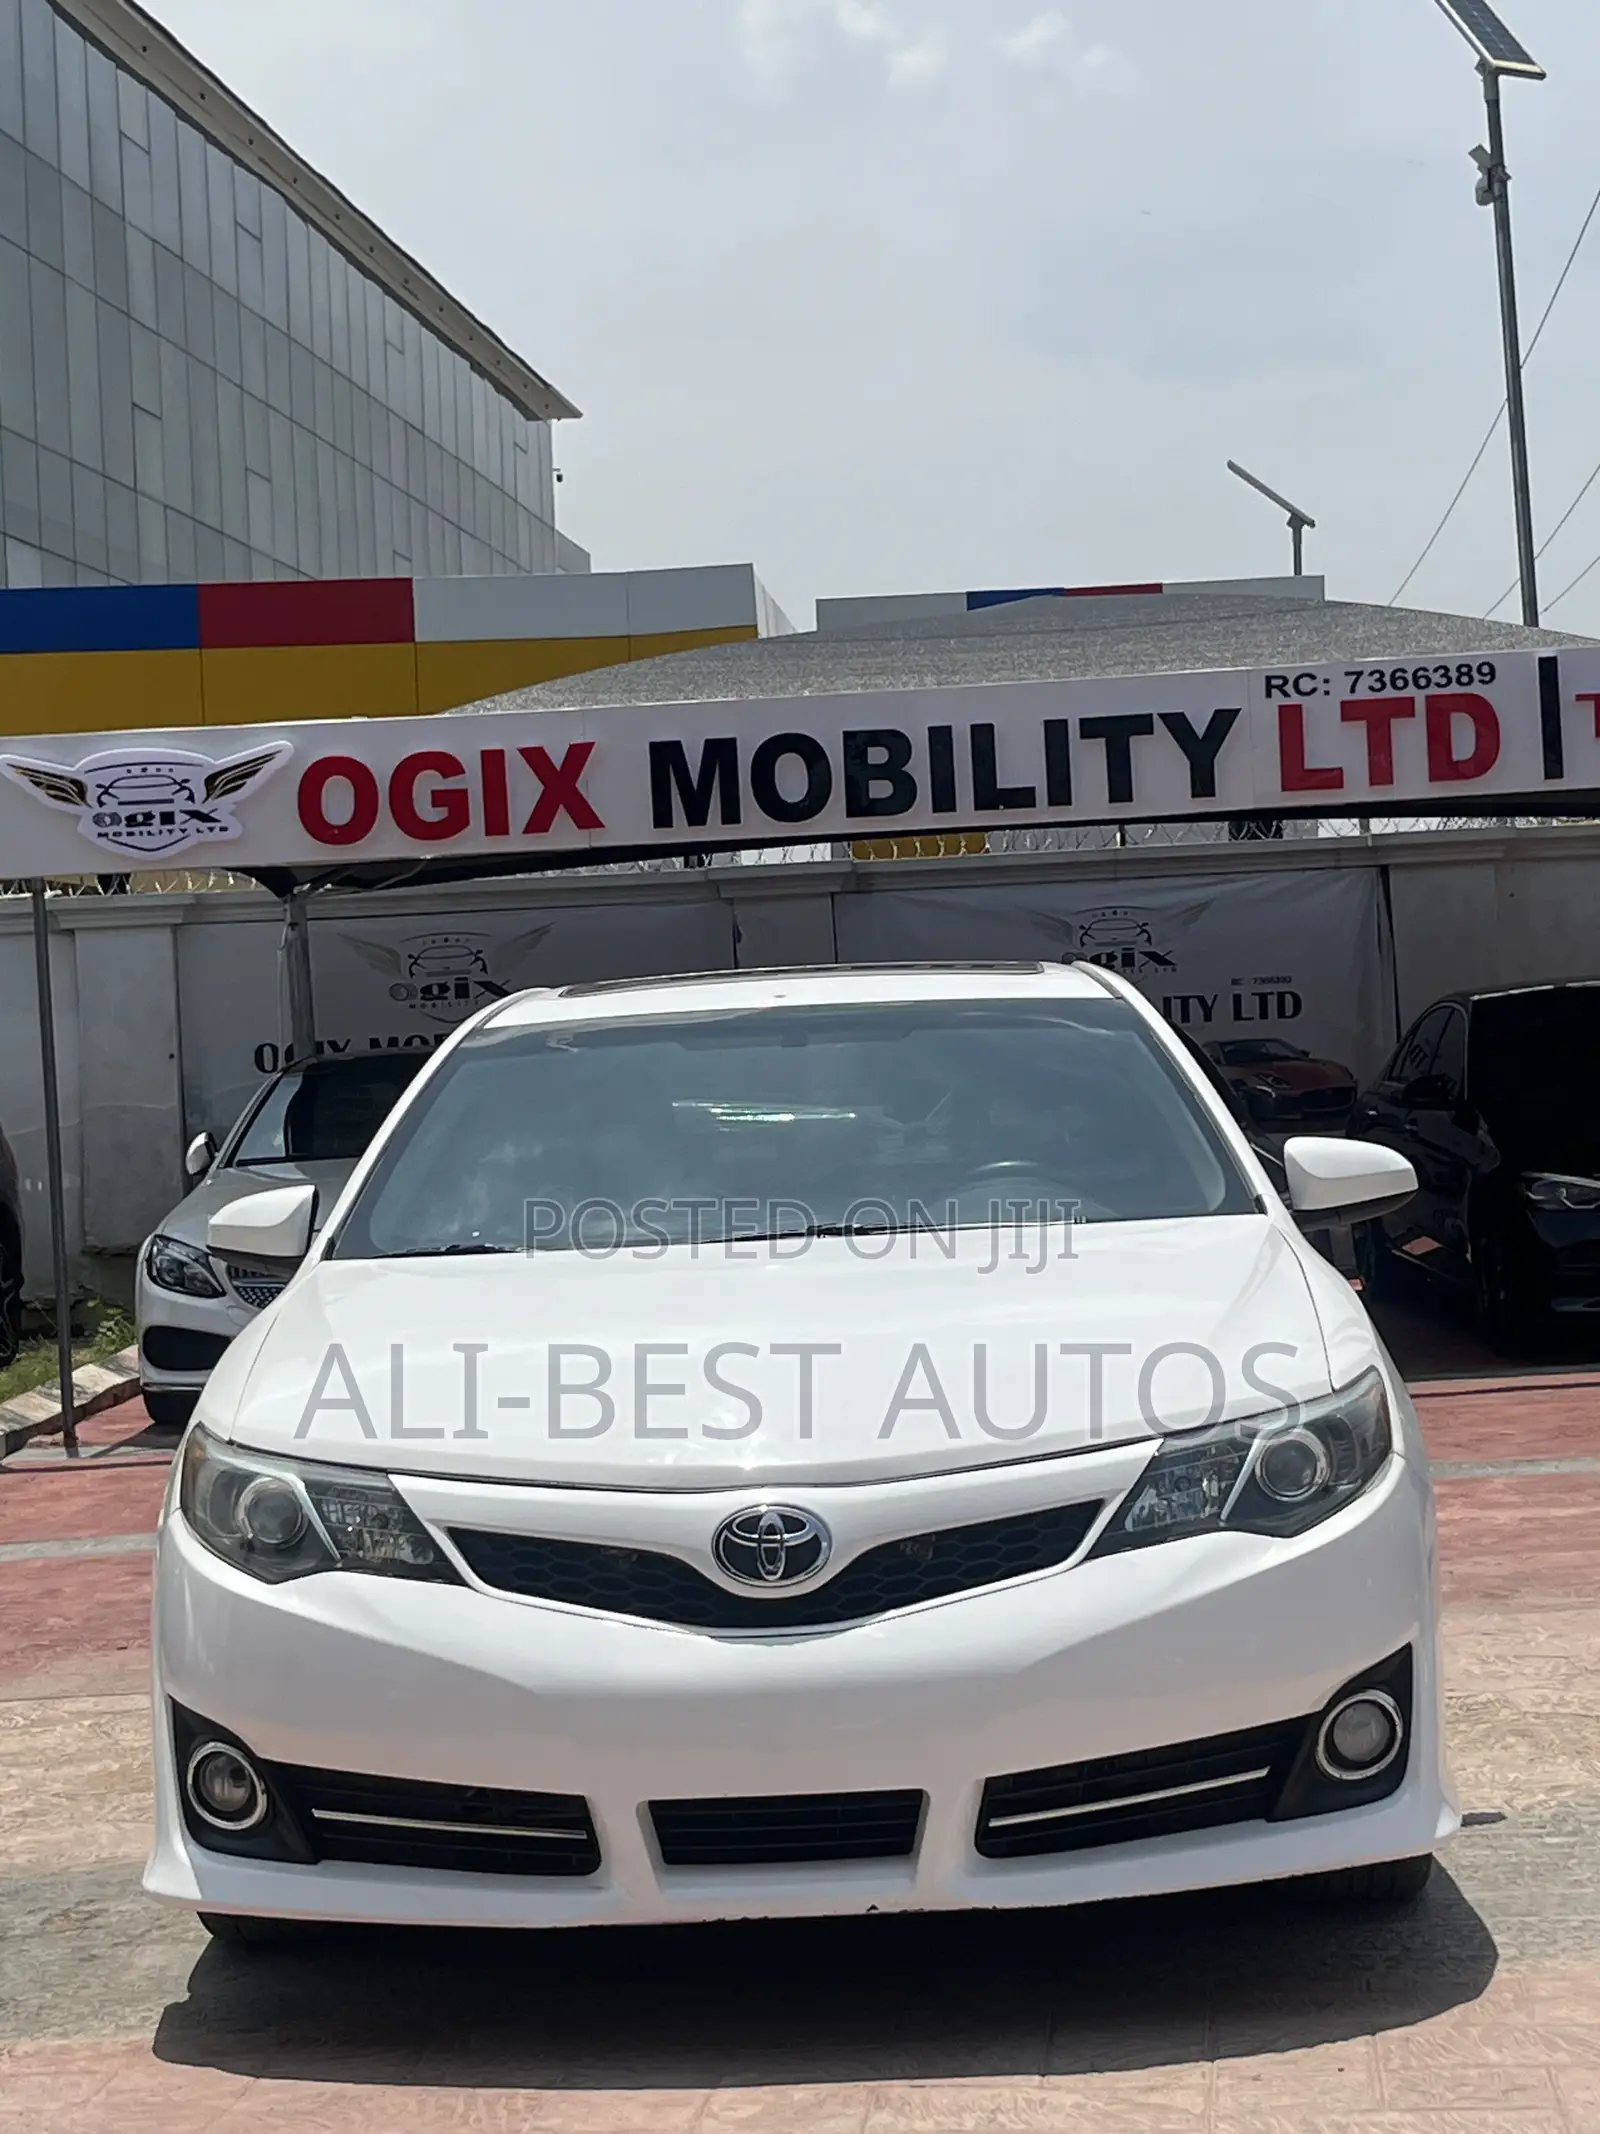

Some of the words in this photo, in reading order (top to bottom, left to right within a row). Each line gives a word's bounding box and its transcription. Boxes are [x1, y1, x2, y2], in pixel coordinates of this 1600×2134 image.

[1264, 673, 1331, 699] RC:
[1344, 661, 1497, 695] 7366389
[297, 741, 605, 845] OGIX
[648, 707, 1242, 829] MOBILITY
[1278, 692, 1501, 792] LTD
[1232, 990, 1303, 1022] LTD
